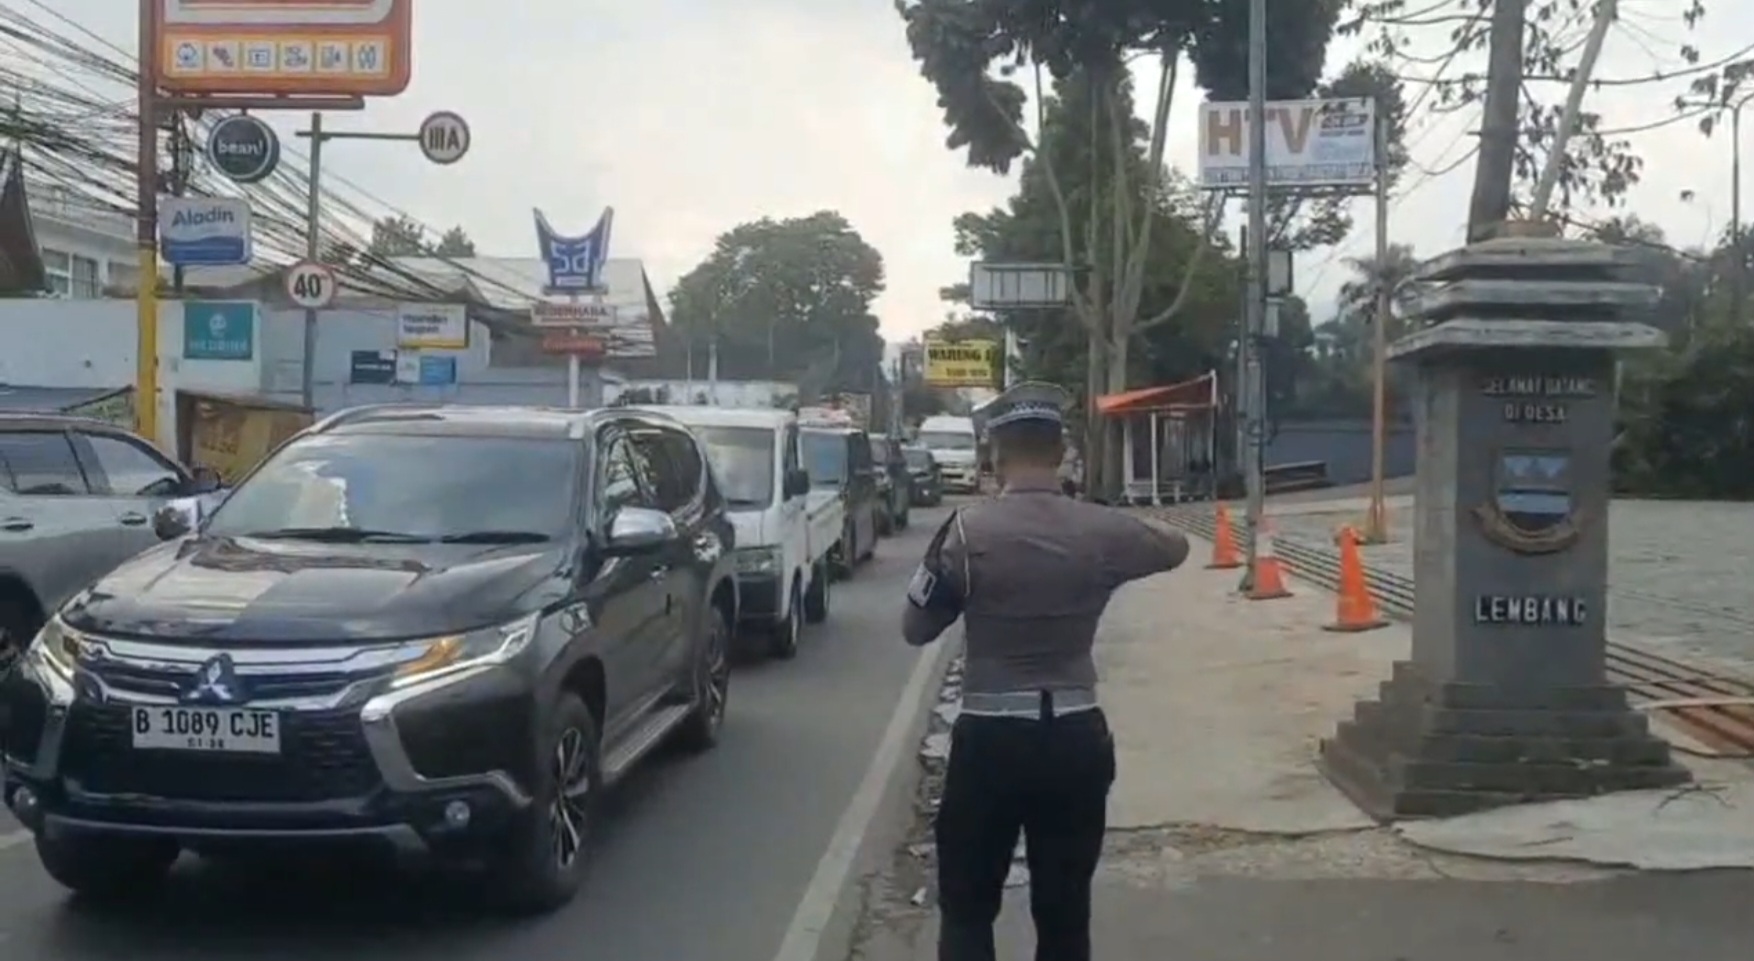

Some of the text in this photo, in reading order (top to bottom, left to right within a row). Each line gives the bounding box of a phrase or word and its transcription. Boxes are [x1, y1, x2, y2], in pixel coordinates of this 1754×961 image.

[172, 205, 235, 227] Aladin
[294, 273, 321, 298] 40
[1475, 594, 1587, 622] LEMBANG
[136, 708, 274, 738] B 1089 CJE
